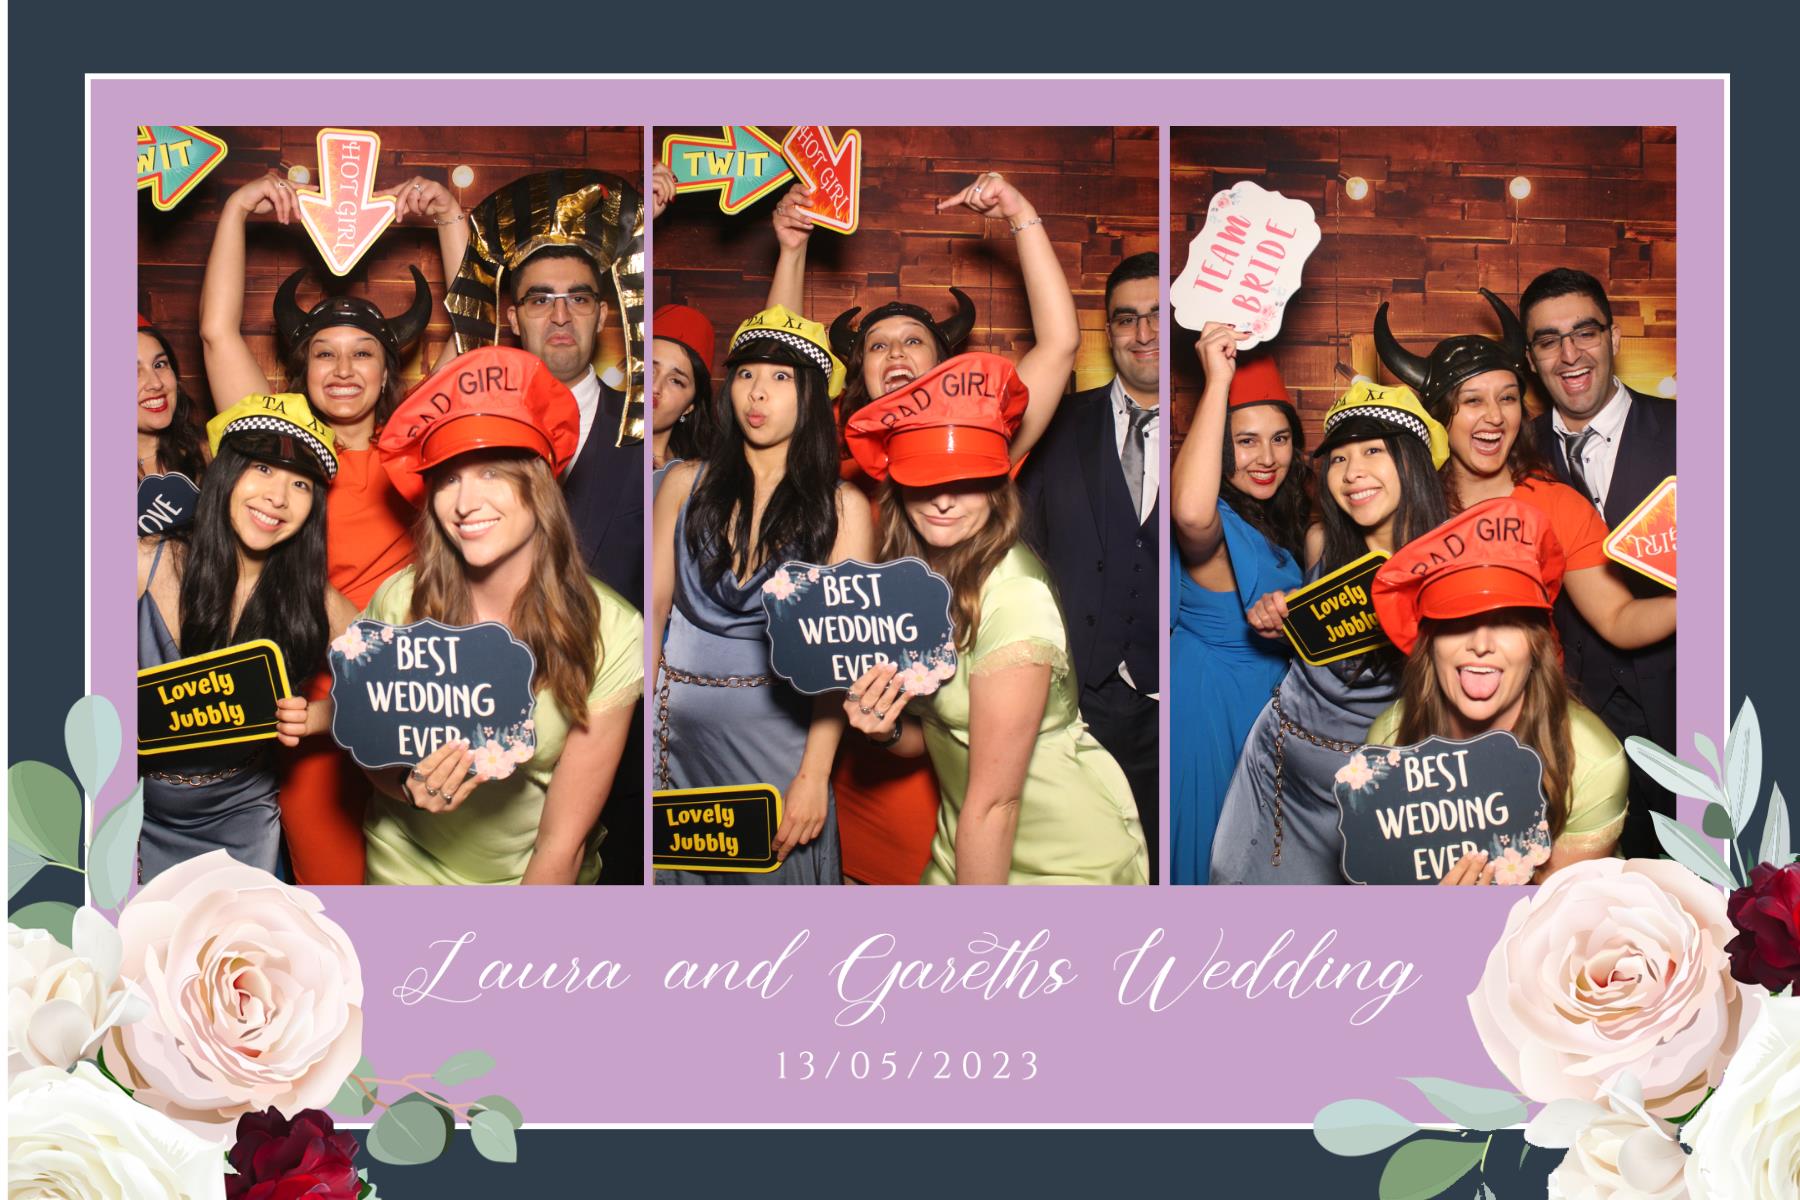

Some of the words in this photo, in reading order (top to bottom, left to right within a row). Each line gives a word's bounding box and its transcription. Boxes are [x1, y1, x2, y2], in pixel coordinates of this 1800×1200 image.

[340, 141, 361, 197] HOT
[682, 151, 770, 177] TWIT
[797, 126, 829, 171] HOT
[819, 166, 850, 219] GIRL
[332, 200, 358, 254] GIRL
[1193, 215, 1252, 293] TEAM
[1231, 217, 1297, 313] BRIDE
[458, 366, 518, 395] GIRL
[941, 372, 996, 399] GIRL
[1476, 517, 1533, 546] GIRL
[820, 573, 882, 610] BEST
[1309, 584, 1368, 621] Lovely
[798, 612, 919, 646] WEDDING
[396, 635, 461, 677] BEST
[157, 670, 235, 706] Lovely
[366, 681, 496, 719] WEDDING
[168, 701, 246, 732] Jubbly
[1404, 749, 1469, 793] BEST
[666, 803, 735, 828] Lovely
[1375, 791, 1510, 840] WEDDING
[669, 831, 739, 857] Jubbly
